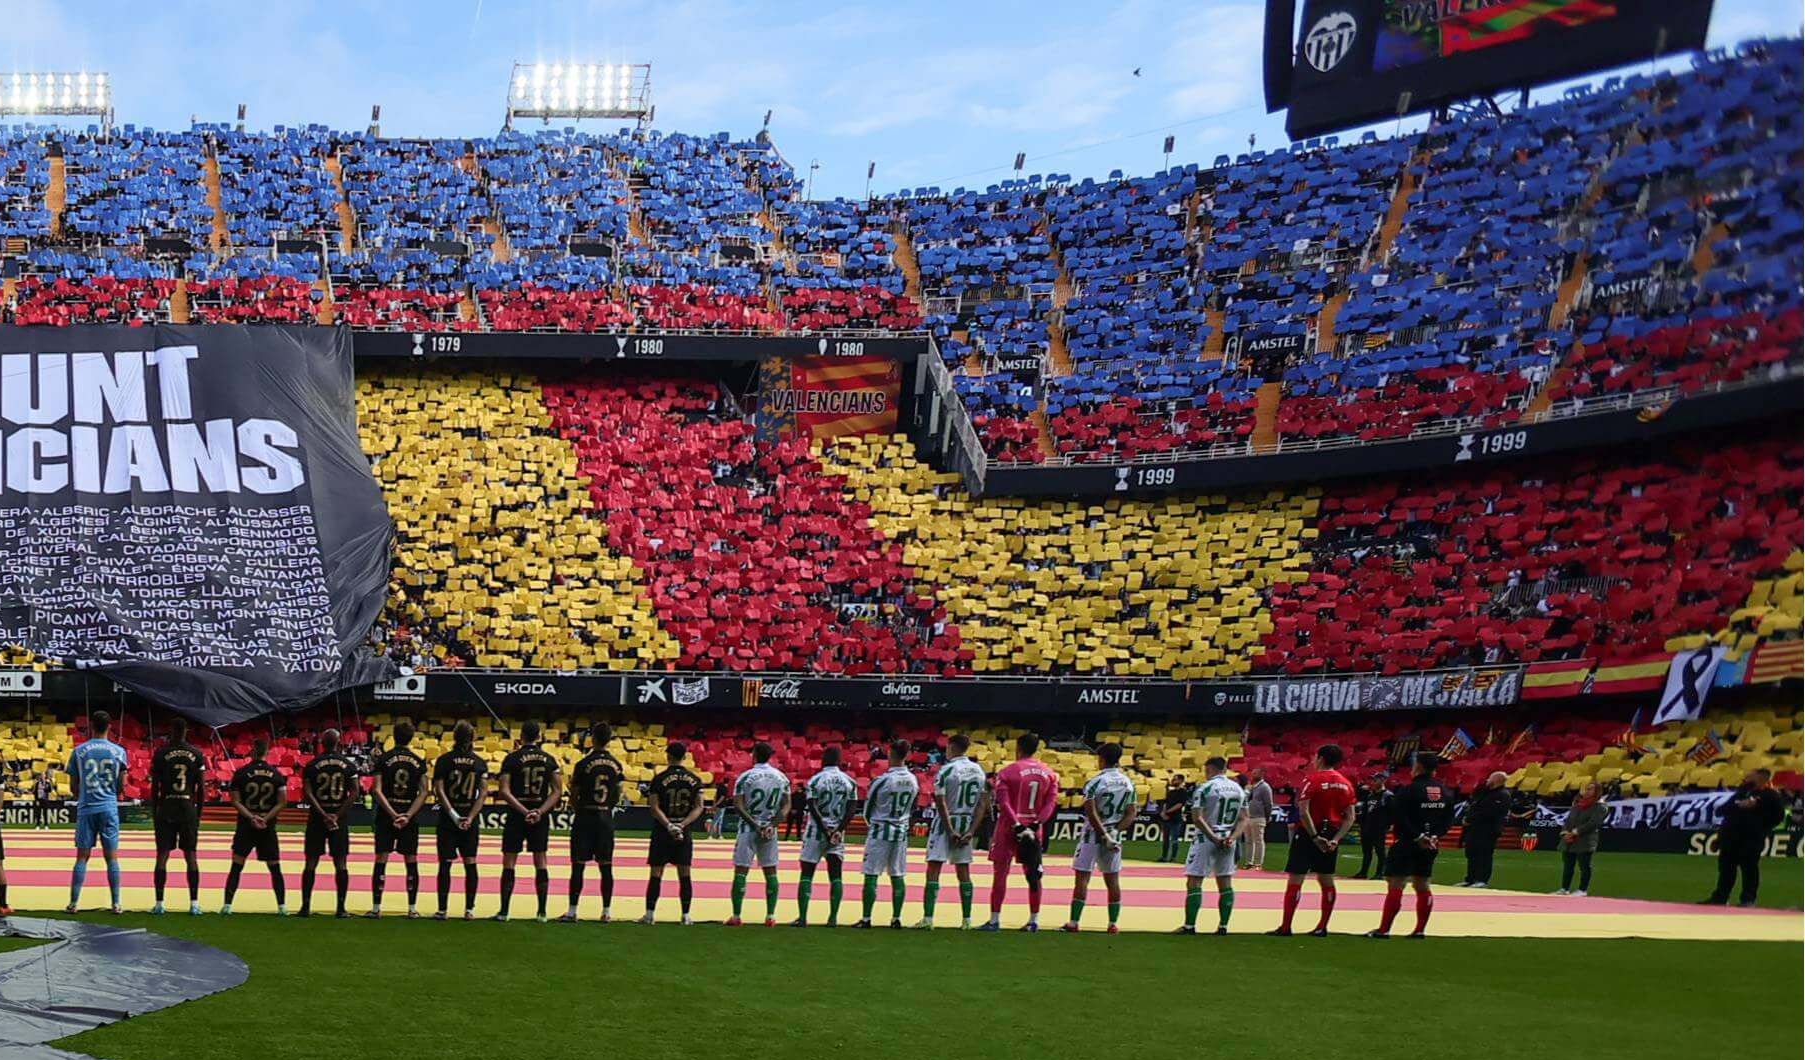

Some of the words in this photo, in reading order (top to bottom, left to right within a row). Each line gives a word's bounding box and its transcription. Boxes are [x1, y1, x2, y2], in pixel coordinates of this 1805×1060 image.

[431, 337, 461, 351] 1979
[633, 339, 664, 354] 1980
[835, 342, 864, 356] 1980
[1248, 336, 1299, 351] AMSTEL
[998, 358, 1039, 371] AMSTEL
[771, 388, 886, 415] VALENCIANS
[1481, 431, 1527, 454] 1999
[1137, 467, 1175, 486] 1999
[120, 505, 216, 516] ALBORACHE
[206, 516, 313, 527] ALMUSSAFES
[6, 528, 26, 538] DE
[229, 527, 315, 538] BENIMODO
[124, 543, 197, 555] CATADAU
[224, 546, 320, 556] CATARROJA
[183, 536, 318, 548] CAMPORROBLES
[6, 556, 70, 566] CHESTE
[86, 557, 135, 566] CHIVA
[247, 557, 322, 567] CULLERA
[245, 567, 323, 579] FAITANAR
[60, 573, 205, 586] FUENTERROBLES
[230, 576, 326, 589] GESTALGAR
[102, 588, 122, 597] LA
[129, 588, 186, 598] TORRE
[142, 600, 234, 609] MACASTRE
[254, 596, 330, 608] MANISES
[36, 610, 108, 624] PICANYA
[141, 620, 236, 632] PICASSENT
[271, 616, 333, 629] PINEDO
[254, 627, 337, 641] REQUENA
[292, 638, 340, 650] SILLA
[218, 647, 241, 657] LA
[495, 683, 557, 695] SKODA
[882, 682, 921, 695] divina
[1078, 689, 1139, 704] AMSTEL
[1256, 684, 1280, 713] LA
[1285, 680, 1360, 712] CURVA
[84, 758, 114, 789] 25
[172, 764, 187, 792] 3
[522, 767, 545, 794] 15
[316, 772, 344, 800] 20
[450, 770, 475, 800] 24
[246, 782, 275, 809] 22
[750, 787, 780, 815] 24
[959, 781, 979, 807] 16
[1028, 781, 1039, 809] 1
[889, 791, 912, 817] 19
[1217, 796, 1238, 824] 15
